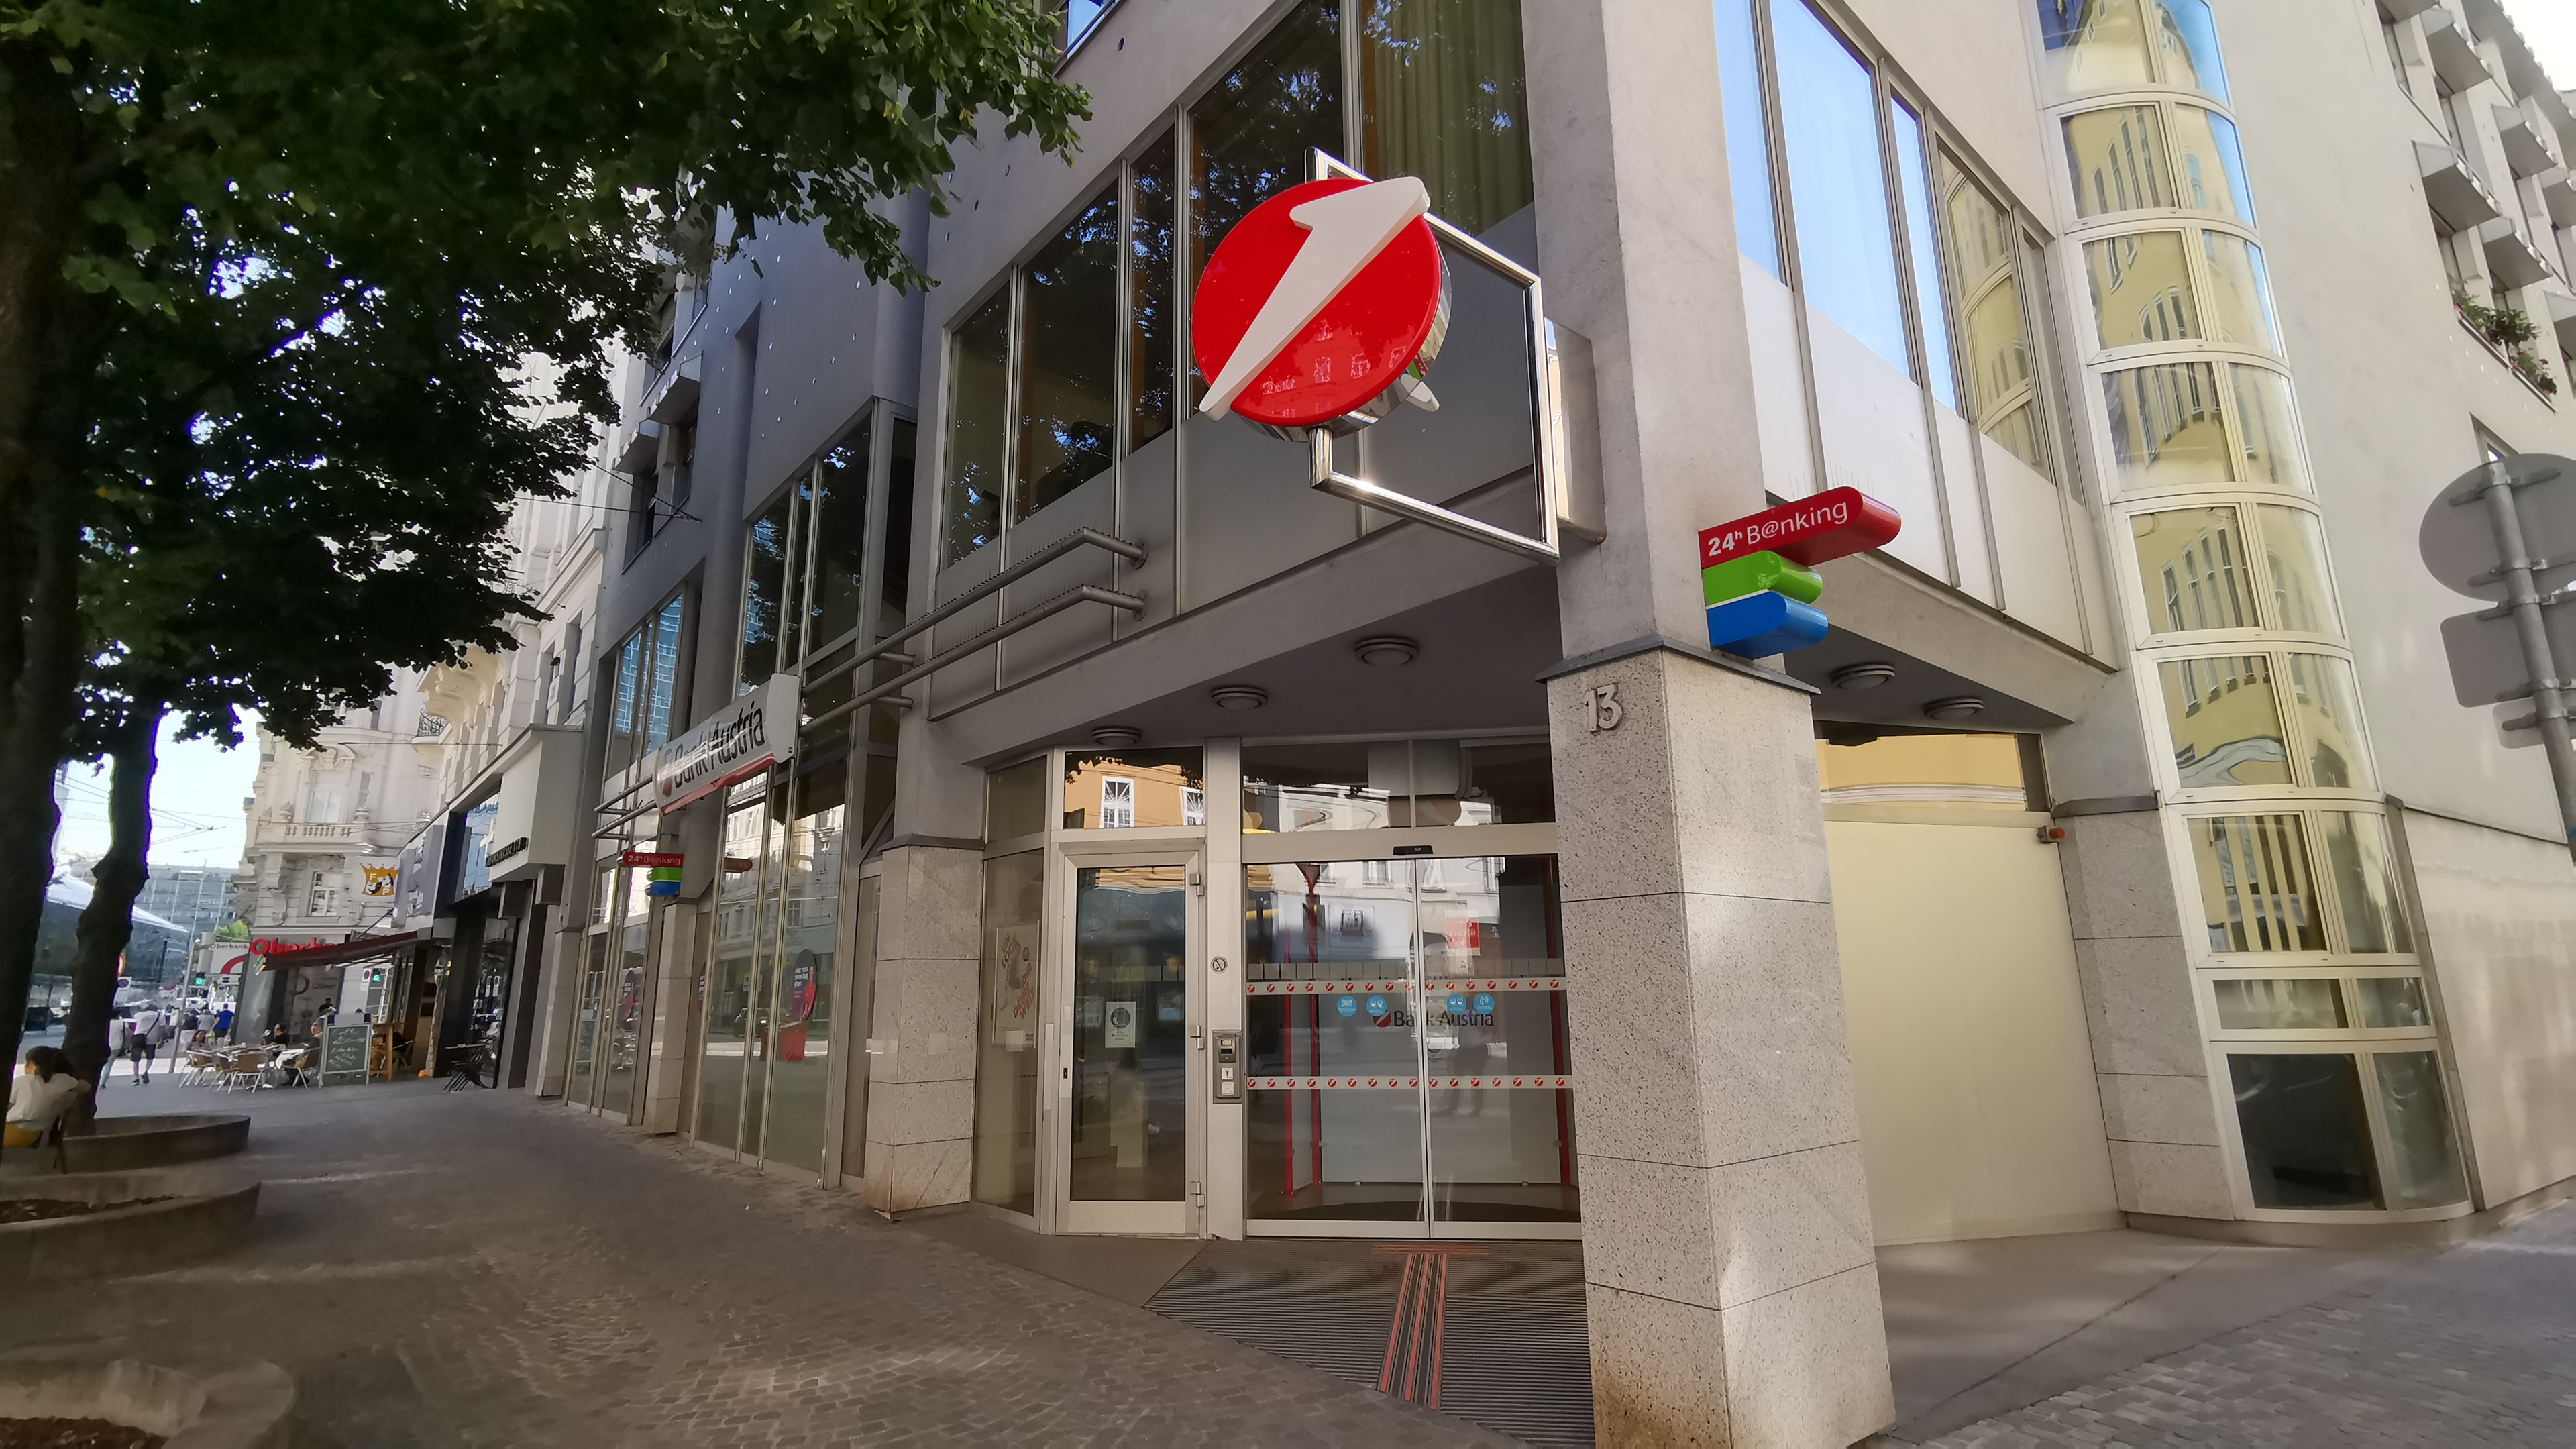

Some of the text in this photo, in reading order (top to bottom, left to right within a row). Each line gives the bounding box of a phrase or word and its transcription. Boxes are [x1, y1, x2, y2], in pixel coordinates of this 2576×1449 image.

[1708, 501, 1849, 557] 24h B@nking
[1582, 683, 1623, 732] 13
[674, 700, 765, 788] Bank Austria
[644, 856, 680, 865] Bnking
[1394, 1010, 1495, 1026] Bak Austria
